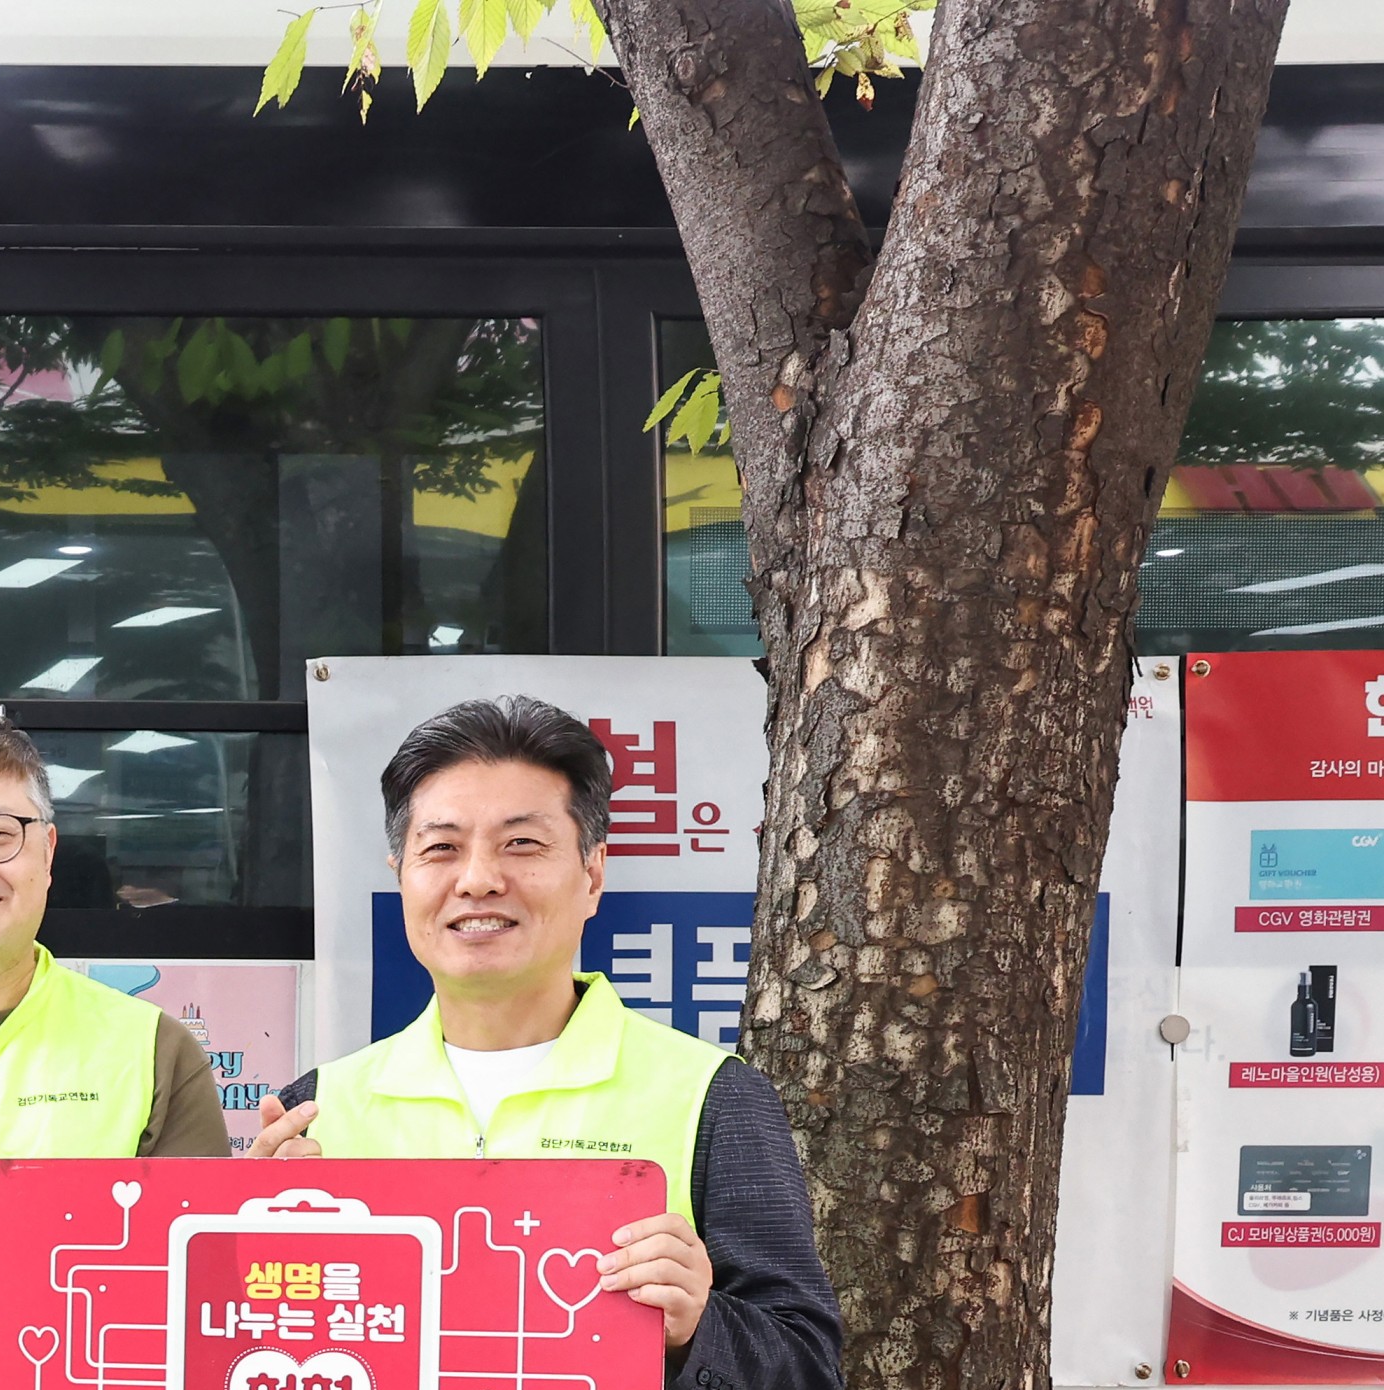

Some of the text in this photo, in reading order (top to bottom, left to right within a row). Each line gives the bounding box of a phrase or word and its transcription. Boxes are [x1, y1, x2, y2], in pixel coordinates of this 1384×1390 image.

[1310, 760, 1362, 778] 감사의
[1351, 836, 1379, 847] CGV
[1258, 910, 1371, 927] CGV 영화관람권
[1241, 1065, 1380, 1083] 레노마올인원(남성용)
[17, 1092, 99, 1107] 검단기독교연합회
[540, 1137, 633, 1153] 검단기독교연합회
[1227, 1226, 1376, 1243] CJ 모바일상품권(5,000원)
[244, 1261, 362, 1301] 생명을
[200, 1301, 406, 1343] 나누는 실천
[1305, 1308, 1354, 1322] 기념품은
